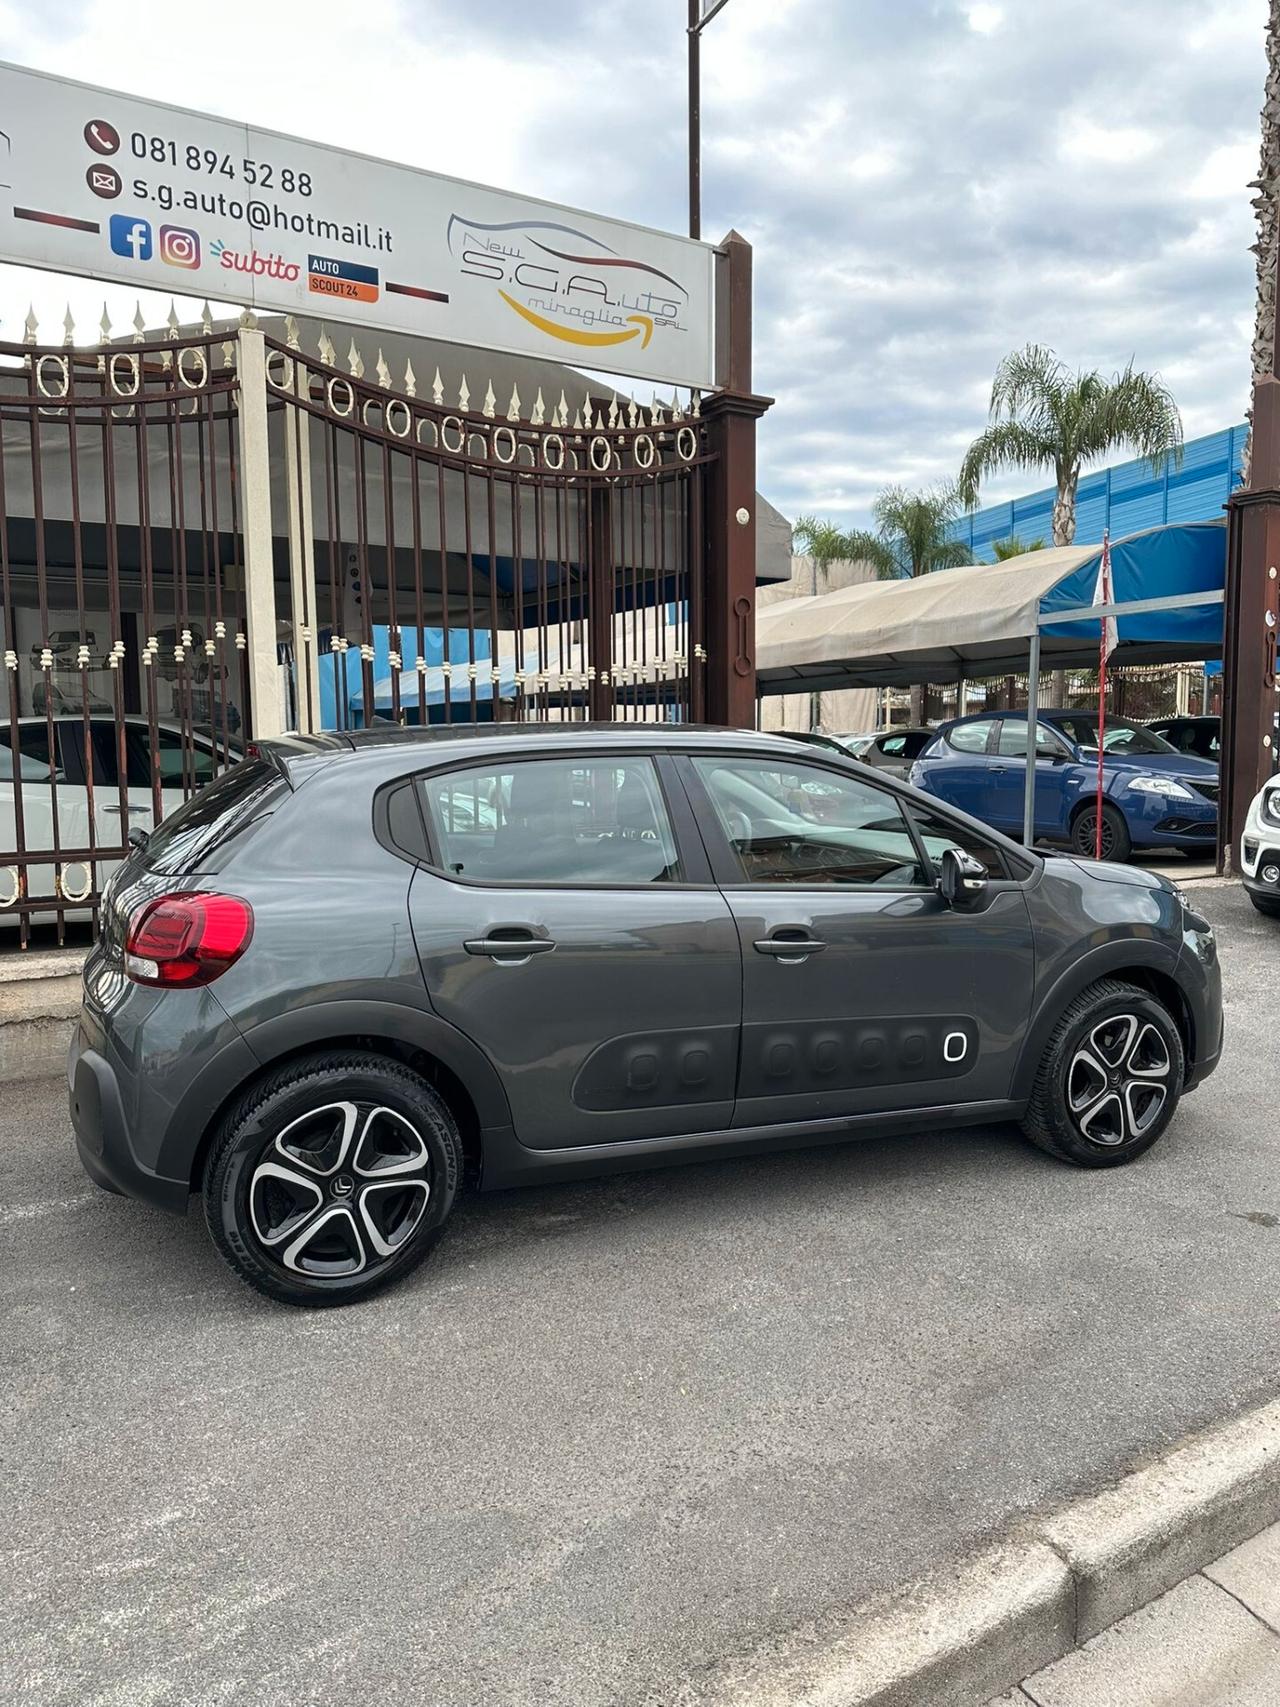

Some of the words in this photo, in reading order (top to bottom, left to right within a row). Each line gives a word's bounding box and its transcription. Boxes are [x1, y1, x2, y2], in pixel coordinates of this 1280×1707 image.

[131, 132, 177, 166] 081
[186, 145, 235, 180] 894
[243, 158, 274, 189] 52
[281, 168, 313, 197] 88
[132, 178, 393, 252] s.g.auto@hotmail.it
[220, 249, 301, 282] subito
[312, 259, 339, 275] AUTO
[312, 277, 346, 294] SCOUT
[346, 284, 359, 297] 24
[528, 297, 627, 326] miraglia
